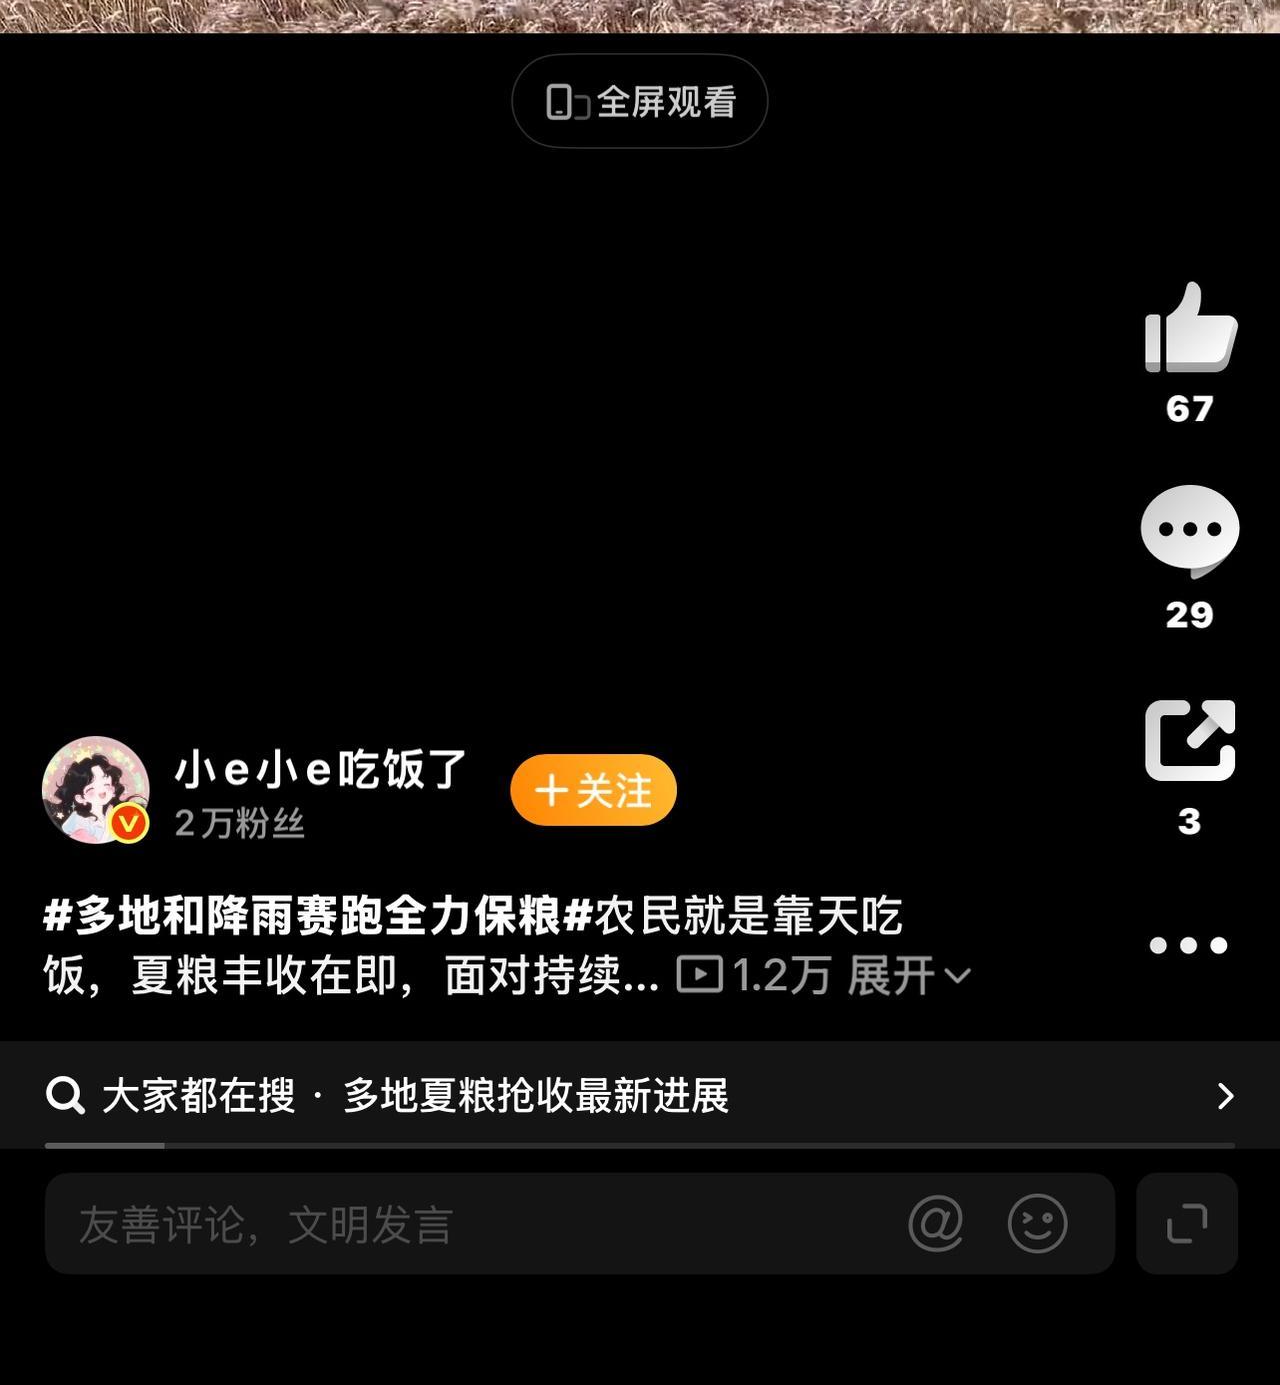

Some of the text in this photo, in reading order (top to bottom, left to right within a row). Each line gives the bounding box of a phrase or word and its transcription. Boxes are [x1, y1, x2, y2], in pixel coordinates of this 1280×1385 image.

[597, 84, 737, 119] 全屏观看
[1166, 394, 1214, 423] 67
[1166, 600, 1214, 629] 29
[175, 806, 305, 840] 2万粉丝
[1178, 807, 1202, 836] 3
[42, 893, 903, 937] #多地和降雨赛跑全力保粮#农民就是靠天吃
[734, 956, 833, 995] 1.2万
[848, 954, 936, 997] 展开
[102, 1076, 296, 1114] 大家都在搜
[343, 1076, 729, 1114] 多地夏粮抢收最新进展
[79, 1204, 454, 1247] 友善评论，文明发言
